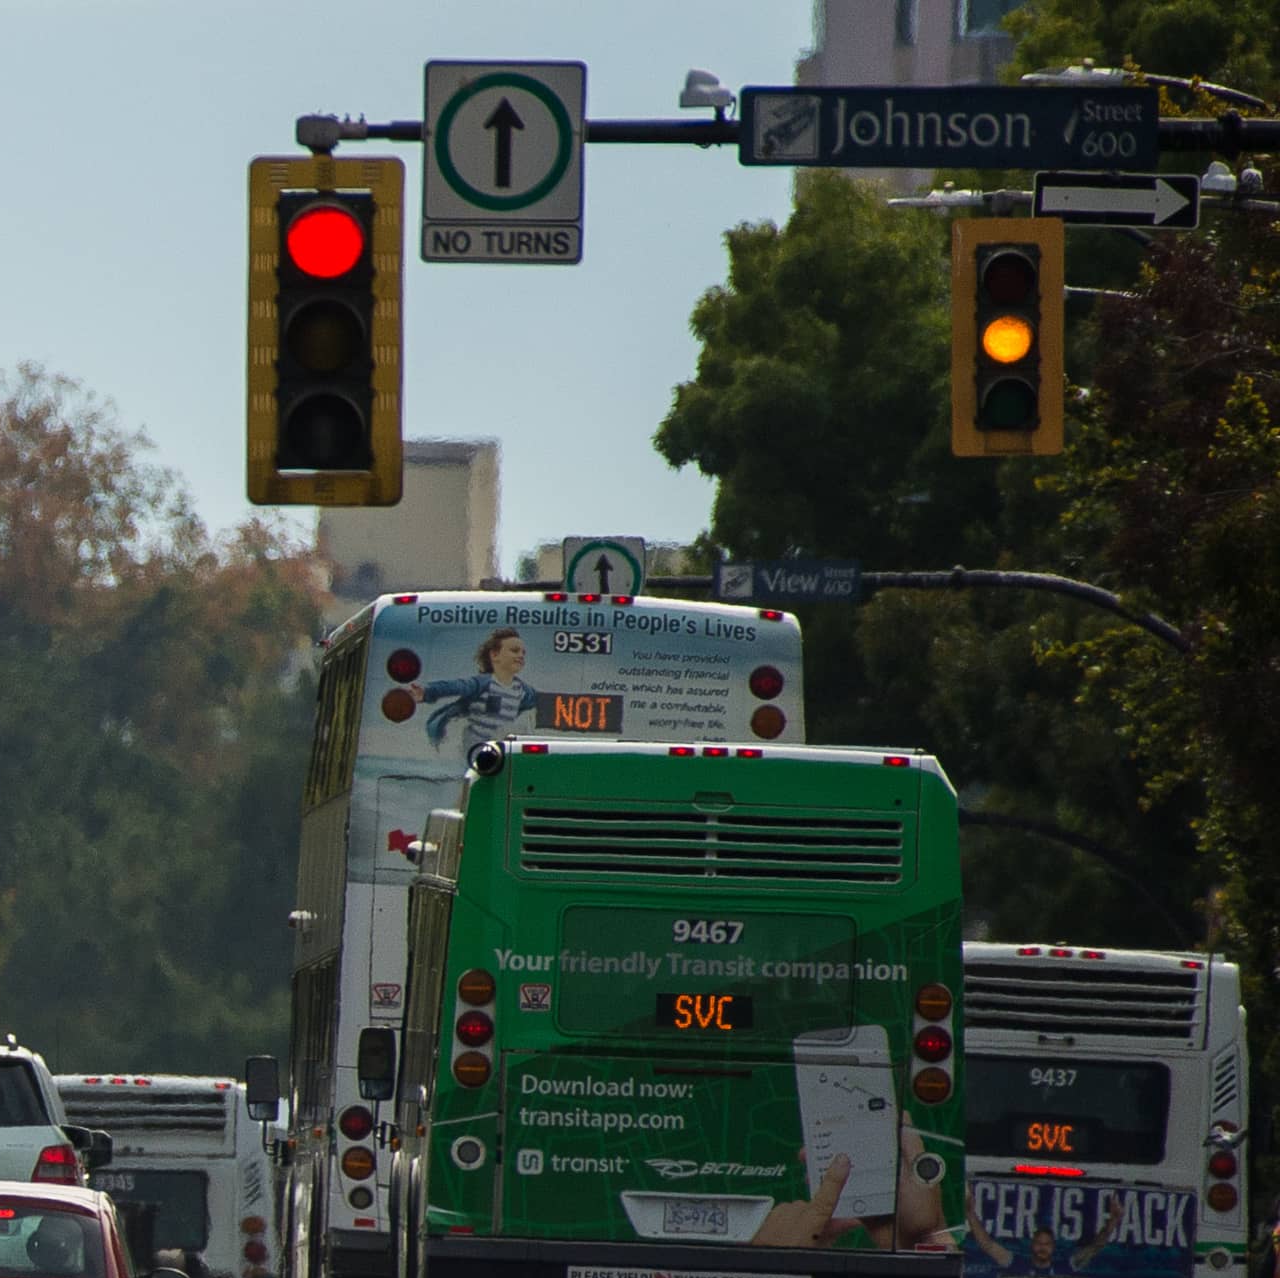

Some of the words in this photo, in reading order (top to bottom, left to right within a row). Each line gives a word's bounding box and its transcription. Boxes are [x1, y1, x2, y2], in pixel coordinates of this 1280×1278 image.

[1083, 99, 1143, 122] Street
[832, 97, 1031, 153] Johnson
[1082, 130, 1137, 157] 600
[432, 230, 471, 253] NO
[482, 231, 570, 254] TURNS
[761, 567, 819, 593] View
[417, 605, 498, 626] Positive
[505, 607, 581, 628] Results
[587, 608, 605, 628] in
[613, 612, 697, 636] People's
[705, 617, 756, 642] Lives
[554, 632, 612, 653] 9531
[633, 651, 652, 661] You
[655, 651, 680, 662] have
[682, 653, 730, 664] provided
[618, 666, 682, 680] outstanding
[684, 667, 730, 680] financial
[632, 683, 663, 695] which
[666, 684, 683, 696] has
[686, 686, 729, 697] assured
[554, 697, 610, 732] NOT
[673, 919, 744, 944] 9467
[494, 948, 554, 971] Your
[559, 949, 661, 979] friendly
[667, 952, 756, 977] Transit
[761, 958, 907, 984] companion
[674, 994, 733, 1030] SVC
[521, 1074, 634, 1097] Download
[640, 1080, 693, 1098] now:
[1029, 1068, 1078, 1088] 9437
[519, 1107, 685, 1133] transitapp.com
[1028, 1122, 1074, 1151] SVC
[551, 1154, 625, 1174] transit
[1053, 1186, 1085, 1241] IS
